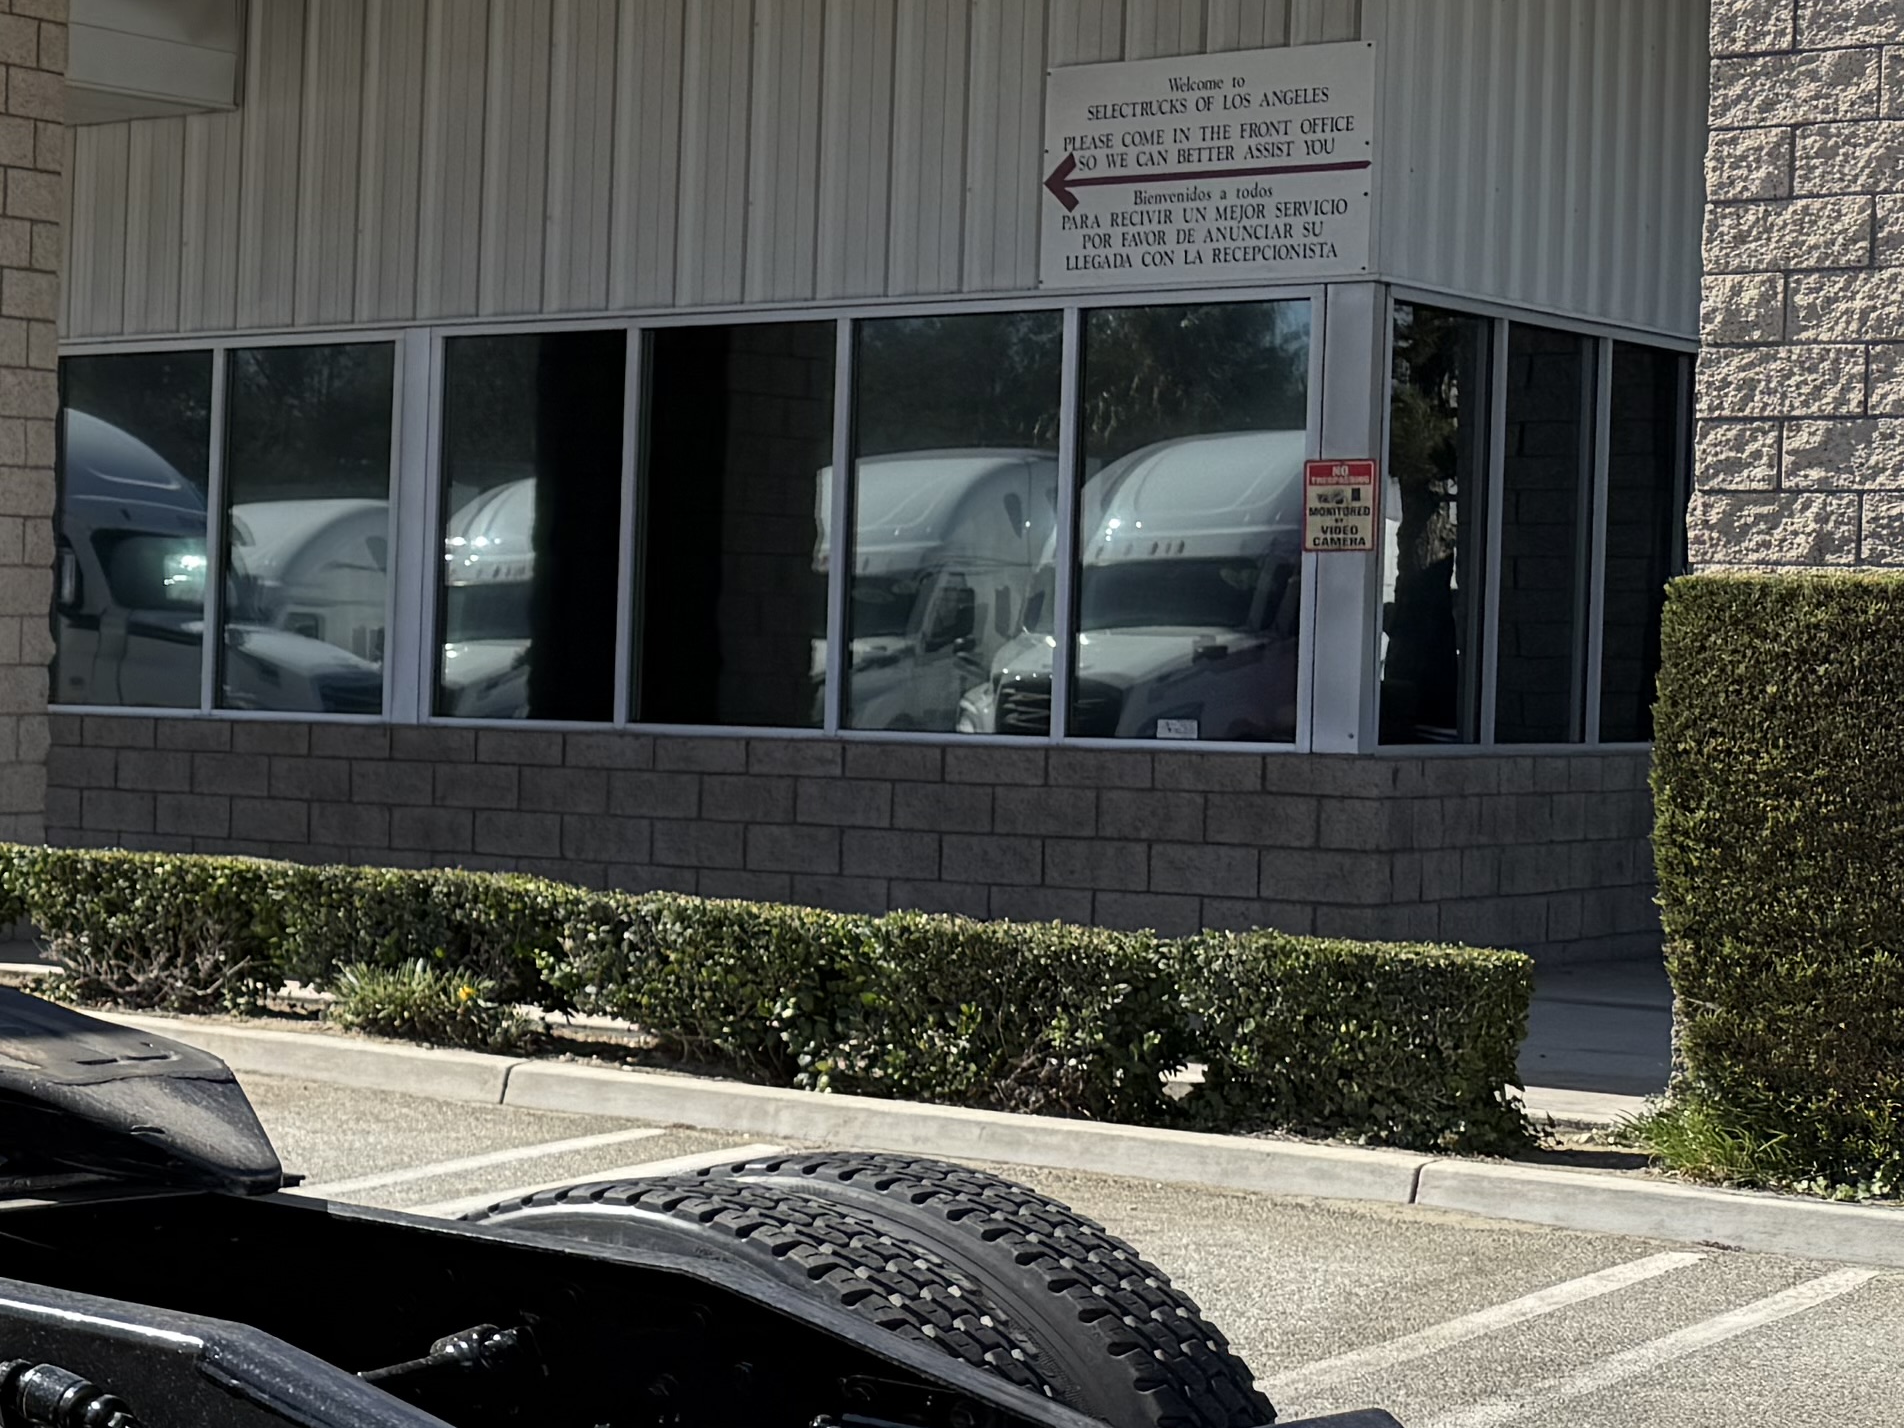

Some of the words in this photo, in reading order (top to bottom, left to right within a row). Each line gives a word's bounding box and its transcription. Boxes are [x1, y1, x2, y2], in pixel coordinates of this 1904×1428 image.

[1168, 76, 1224, 93] Welcome
[1232, 76, 1246, 89] to
[1087, 98, 1188, 121] SELECTRUCKS
[1195, 96, 1215, 113] OF
[1223, 93, 1252, 111] LOS
[1259, 87, 1330, 108] ANGELES
[1063, 133, 1114, 152] PLEASE
[1121, 129, 1165, 147] COME
[1173, 127, 1191, 144] IN
[1200, 124, 1232, 142] THE
[1240, 119, 1293, 139] FRONT
[1300, 115, 1355, 135] OFFICE
[1079, 155, 1097, 171] SO
[1106, 152, 1129, 169] WE
[1136, 150, 1169, 167] CAN
[1177, 145, 1235, 164] BETTER
[1244, 141, 1294, 160] ASSIST
[1304, 137, 1336, 155] YOU
[1133, 187, 1212, 205] Bienvenidos
[1220, 190, 1228, 200] a
[1236, 182, 1273, 199] todos
[1062, 214, 1101, 230] PARA
[1110, 209, 1173, 228] RECIVIR
[1182, 208, 1207, 225] UN
[1215, 203, 1266, 223] MEJOR
[1275, 198, 1348, 219] SERVICIO
[1082, 233, 1112, 250] POR
[1121, 229, 1167, 247] FAVOR
[1176, 228, 1196, 245] DE
[1203, 223, 1293, 243] ANUNCIAR
[1302, 221, 1324, 237] SU
[1066, 252, 1132, 271] LLEGADA
[1141, 250, 1175, 267] CON
[1184, 248, 1203, 265] LA
[1212, 242, 1338, 264] RECEPCIONISTA
[1332, 465, 1349, 477] NO
[1309, 506, 1370, 516] MONITORED
[1313, 537, 1366, 547] CAMERA
[1321, 525, 1358, 535] VIDEO
